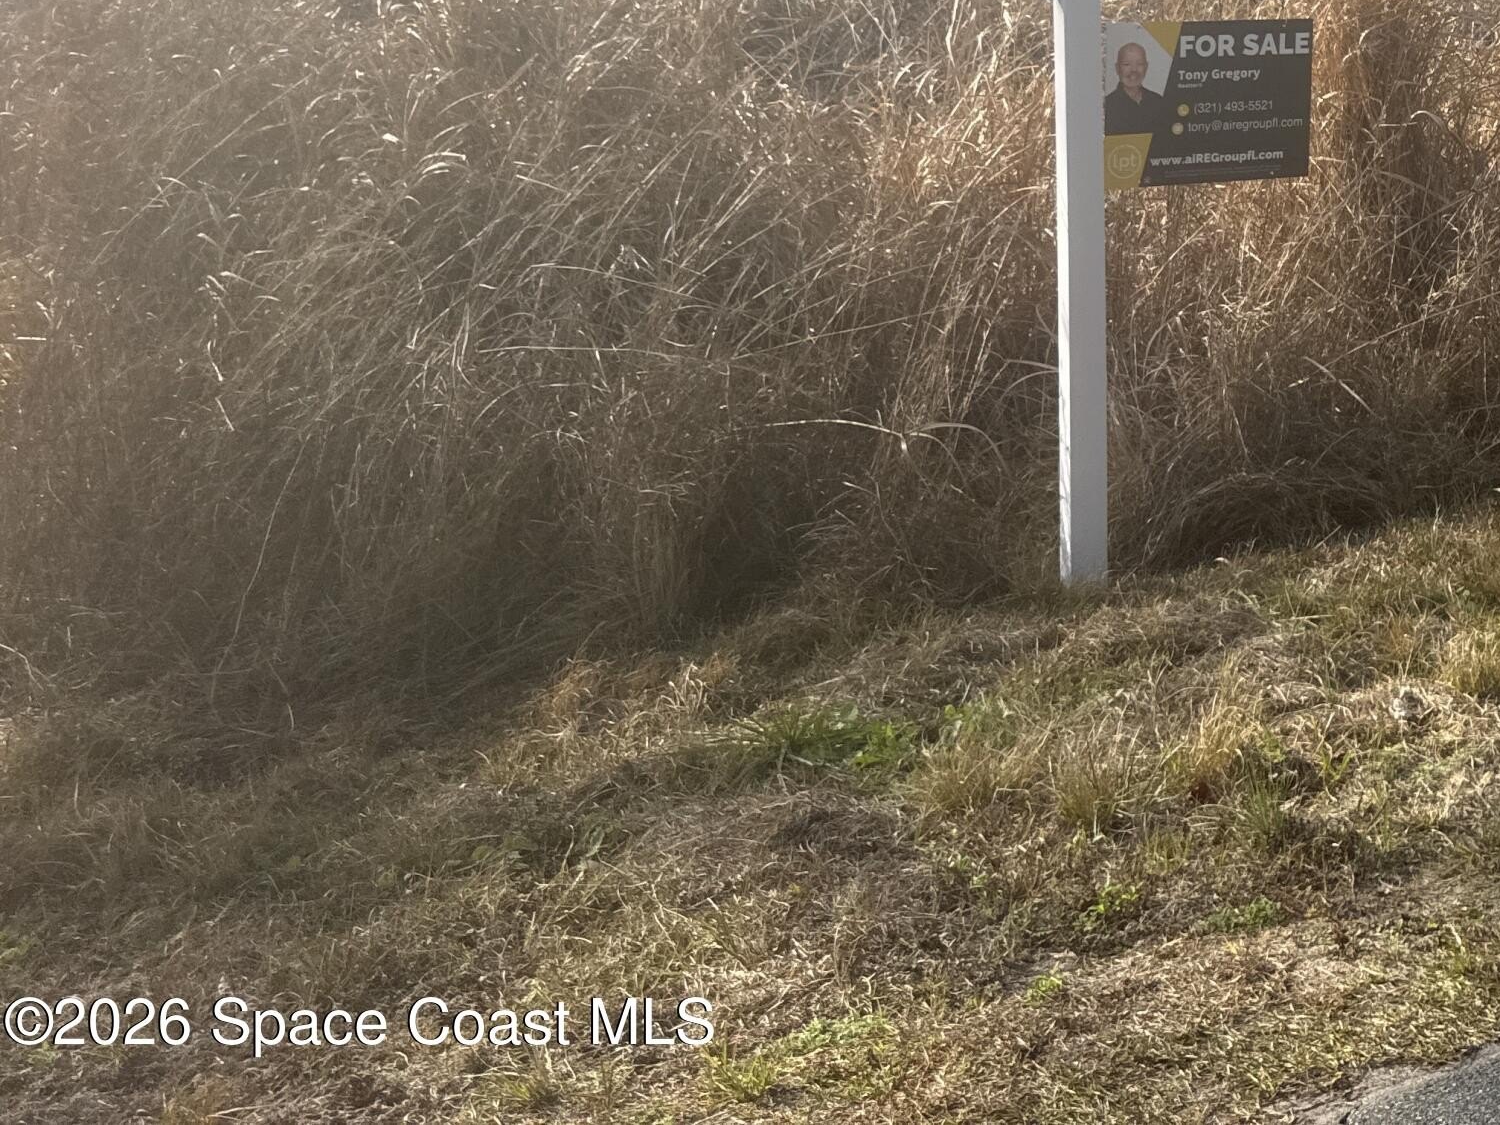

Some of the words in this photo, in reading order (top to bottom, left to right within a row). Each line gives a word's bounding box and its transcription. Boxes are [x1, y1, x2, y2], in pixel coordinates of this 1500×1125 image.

[1180, 34, 1236, 58] FOR
[1242, 32, 1310, 57] SALE
[1177, 69, 1208, 83] Tony
[1211, 68, 1261, 82] Gregory
[1194, 102, 1222, 115] (321)
[1224, 100, 1273, 112] 493-5521
